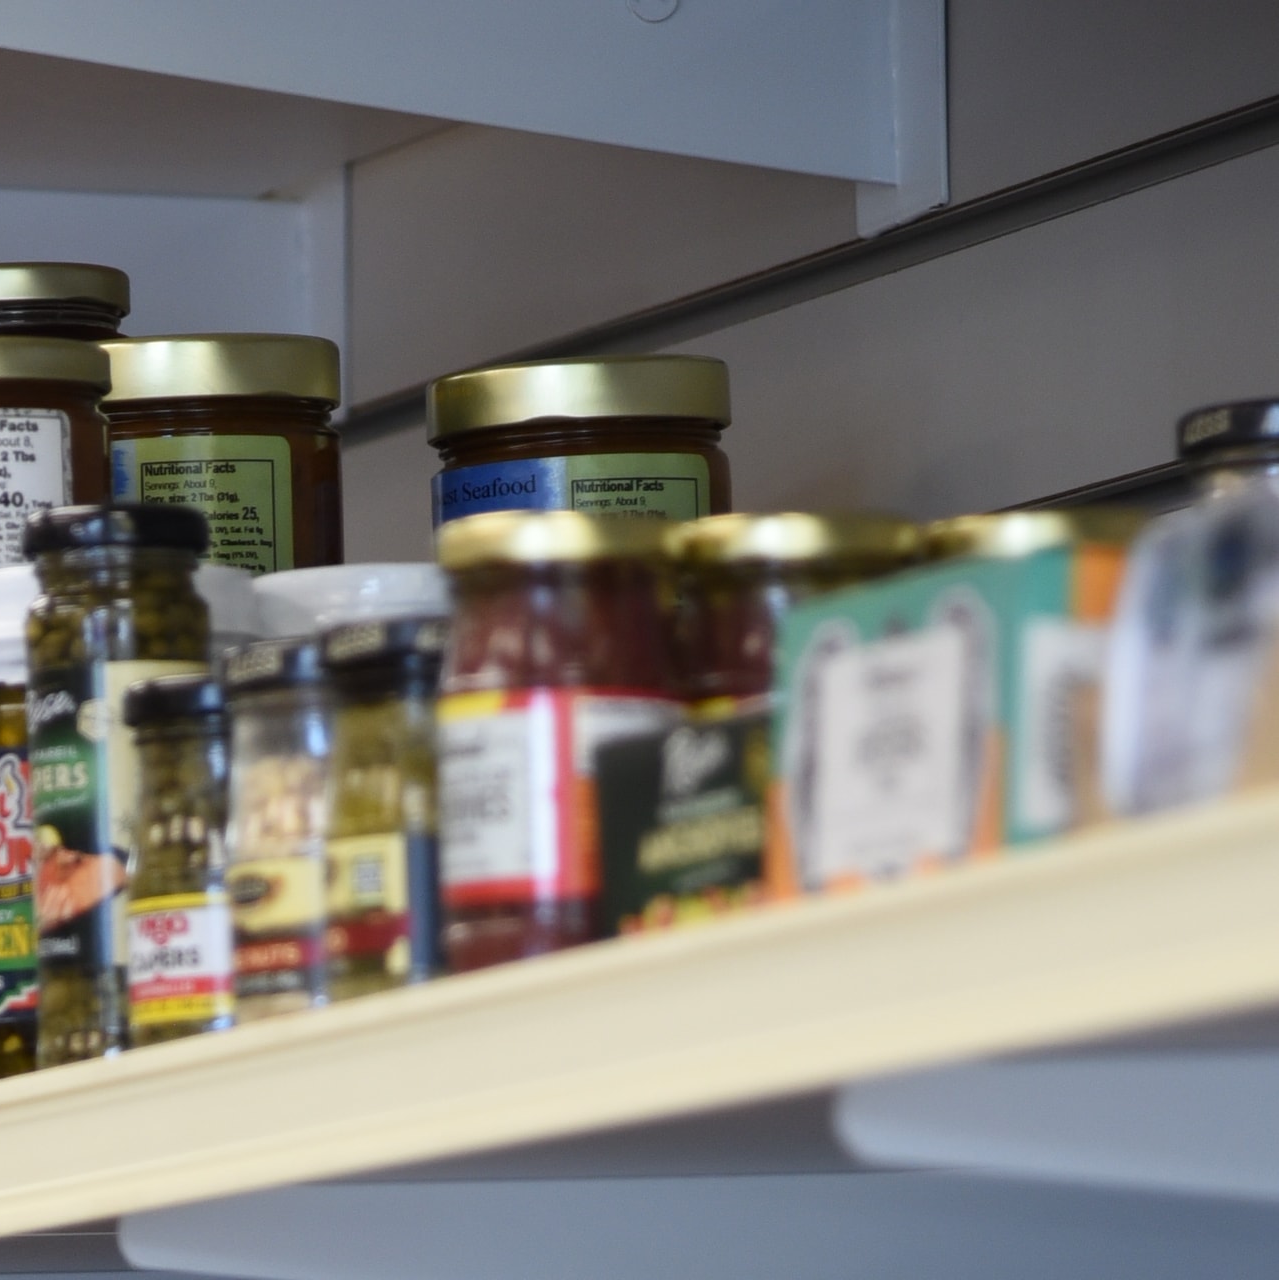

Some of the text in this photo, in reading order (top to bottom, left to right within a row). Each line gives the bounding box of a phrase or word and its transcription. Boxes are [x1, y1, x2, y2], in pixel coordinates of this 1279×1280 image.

[0, 420, 39, 432] Facts
[0, 452, 8, 462] 2
[13, 451, 36, 463] Tbs
[144, 463, 236, 476] Nutritional Facts
[183, 480, 207, 489] About
[461, 474, 537, 502] Seafood
[576, 479, 665, 494] Nutritional Facts
[615, 496, 638, 506] About
[33, 762, 88, 793] PERS
